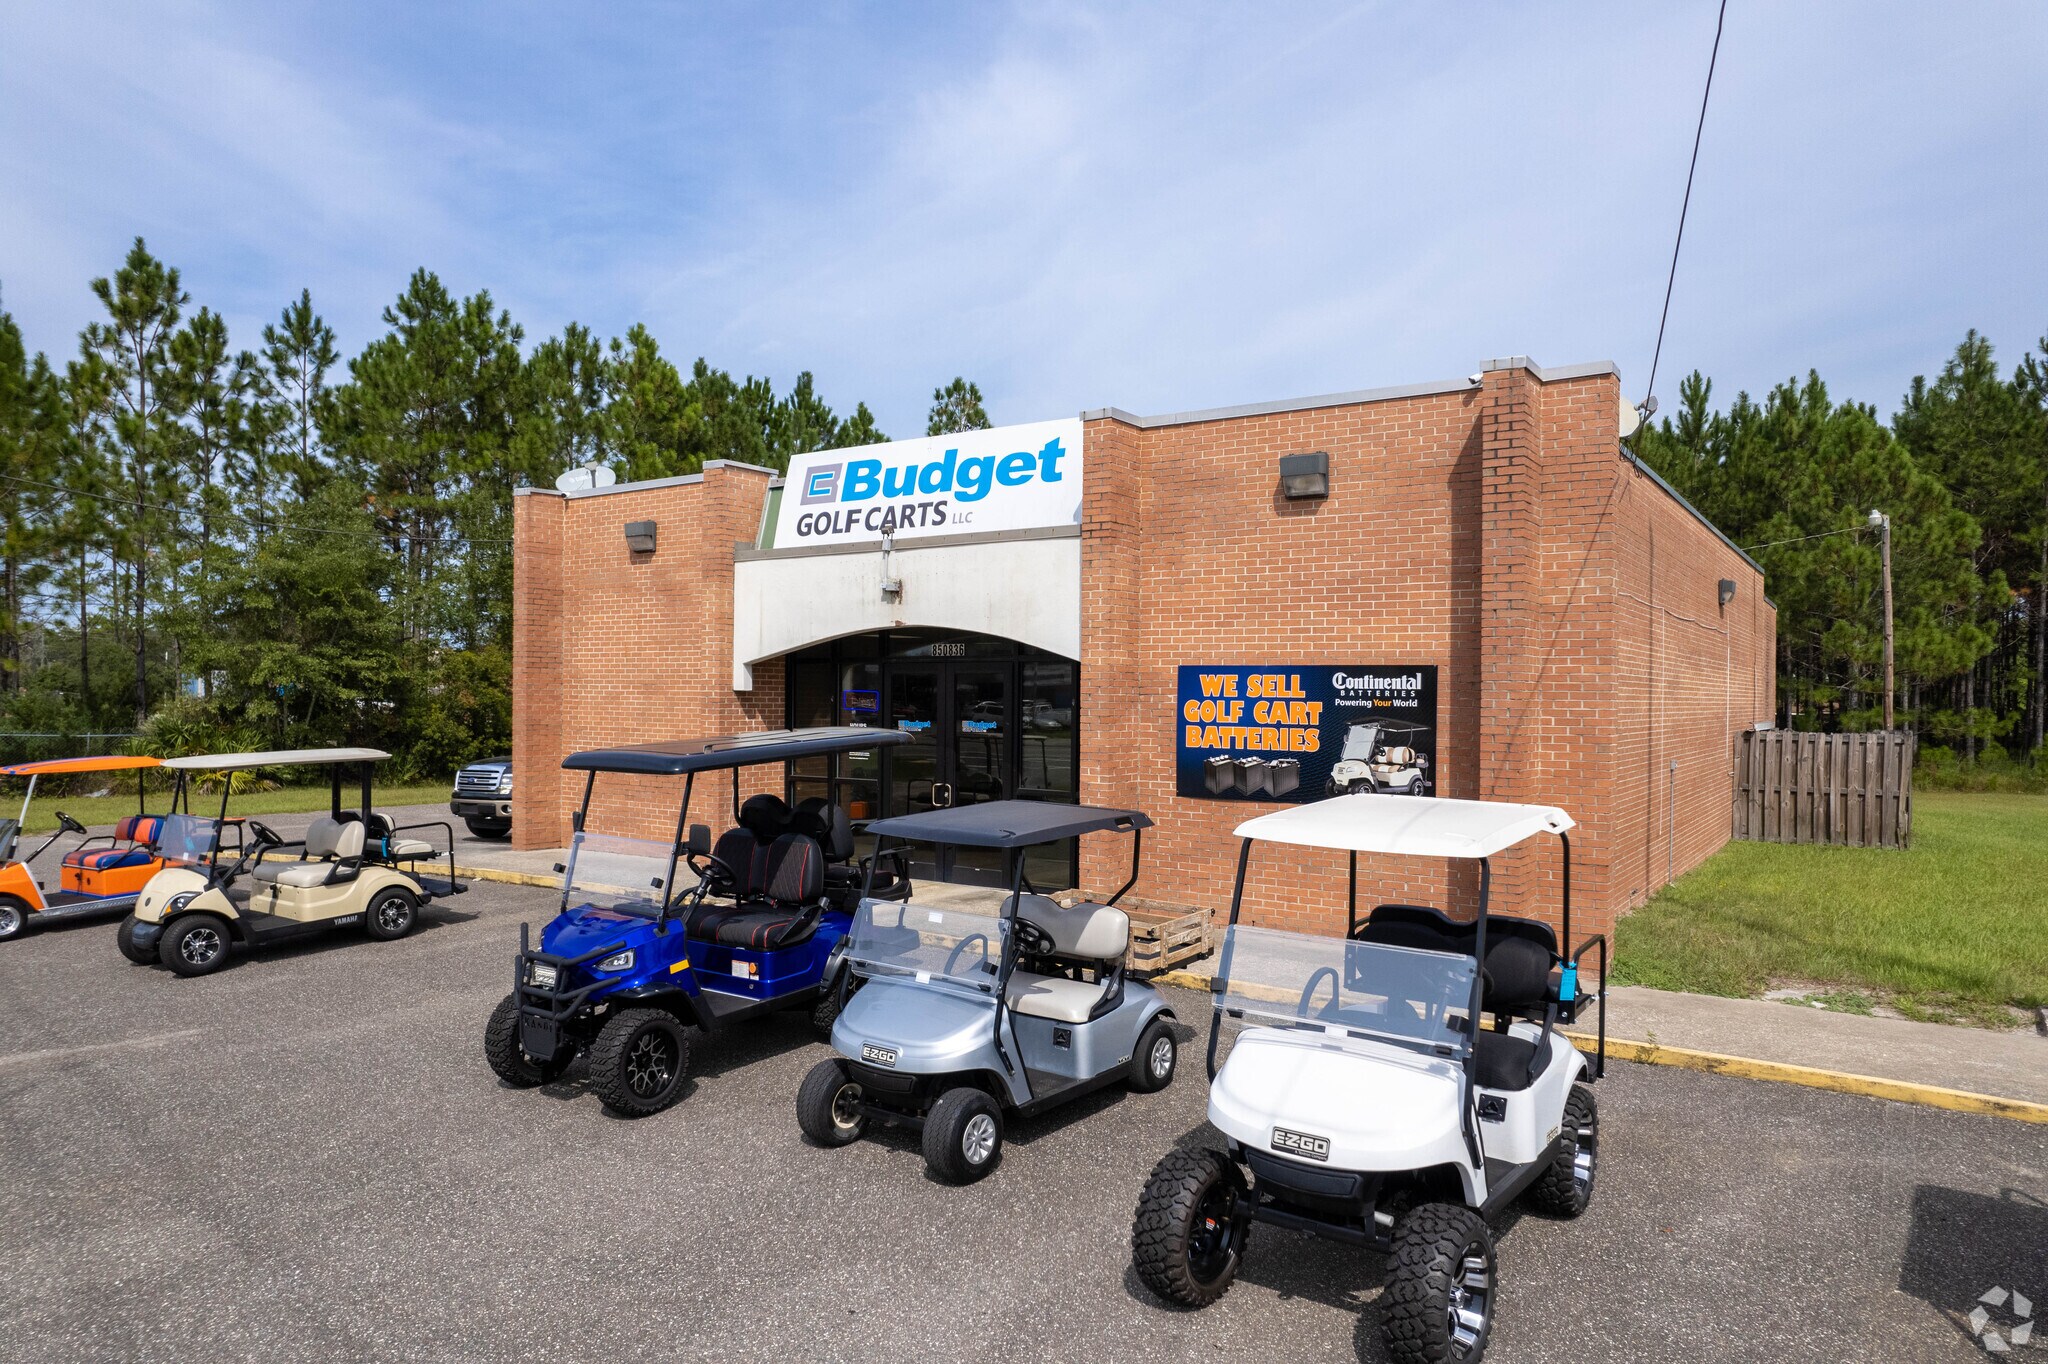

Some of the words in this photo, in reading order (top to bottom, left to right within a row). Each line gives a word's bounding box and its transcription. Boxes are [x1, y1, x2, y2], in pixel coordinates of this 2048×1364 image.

[841, 437, 1066, 502] Budget
[796, 509, 862, 537] GOLF
[864, 500, 948, 531] CARTS
[952, 512, 973, 525] LLC
[932, 644, 964, 656] 850836
[1199, 674, 1239, 697] WE
[1246, 674, 1306, 698] SELL
[1332, 672, 1422, 690] Continental
[1183, 699, 1245, 723] GOLF
[1253, 700, 1323, 725] CART
[1335, 699, 1372, 708] Powering
[1373, 699, 1392, 707] Your
[1393, 699, 1418, 707] World
[1185, 725, 1320, 753] BATTERIES
